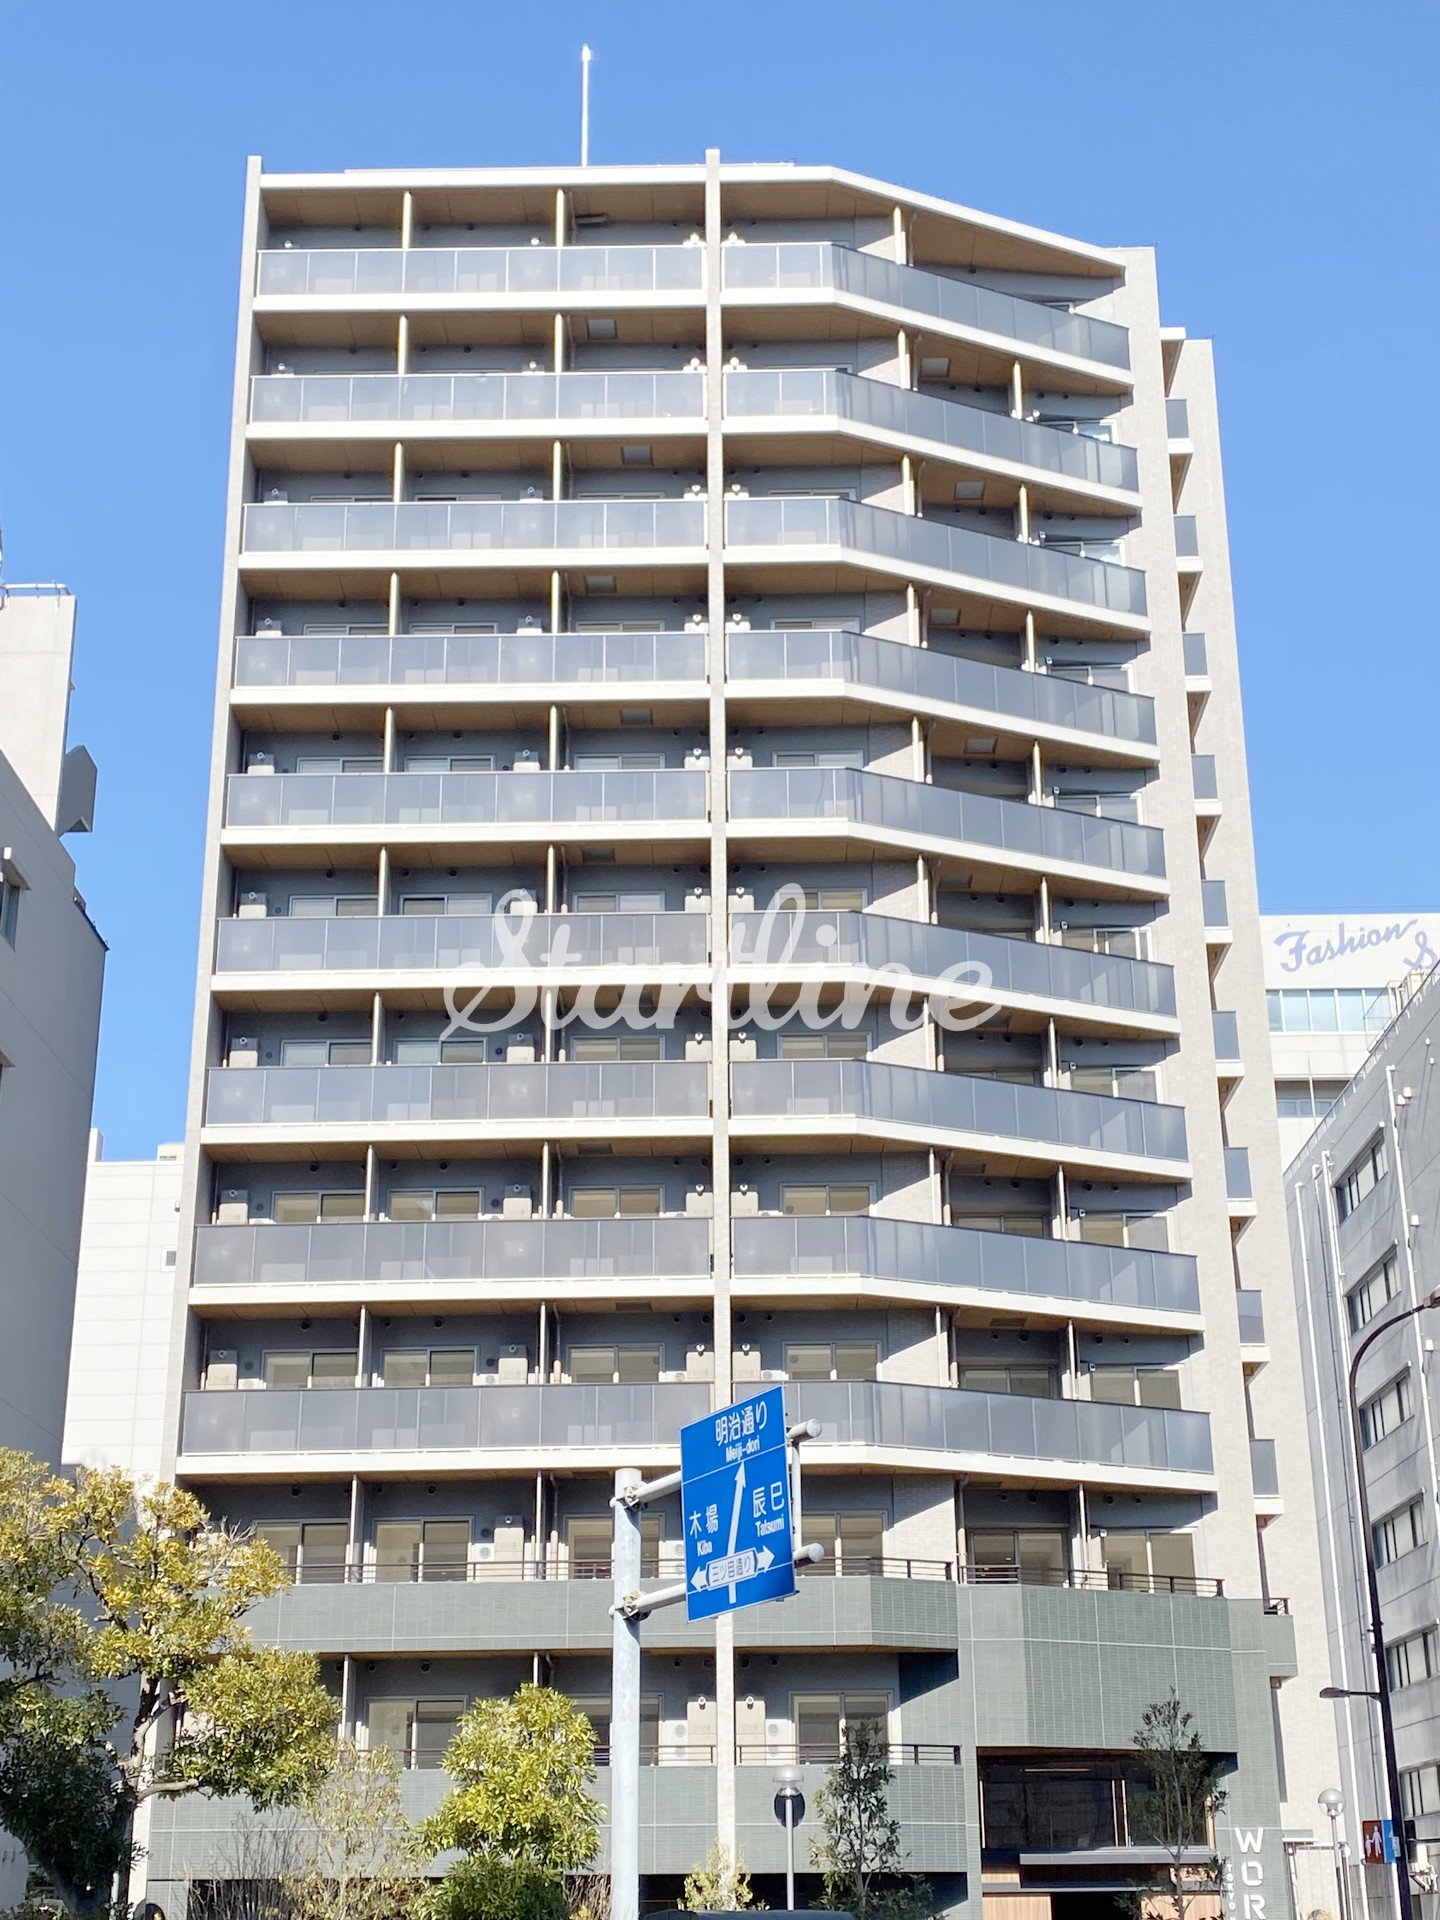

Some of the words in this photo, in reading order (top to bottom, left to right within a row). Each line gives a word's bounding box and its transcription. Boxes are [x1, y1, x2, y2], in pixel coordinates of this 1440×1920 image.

[1273, 918, 1418, 972] Fashion
[715, 1400, 768, 1446] 明治通り
[725, 1434, 761, 1463] Meiji-dori
[752, 1481, 785, 1519] 辰巳
[689, 1503, 719, 1540] 木場
[755, 1513, 785, 1538] Tatsumi
[696, 1539, 713, 1557] Kiba
[711, 1555, 751, 1583] 三ツ目通り
[1225, 1863, 1236, 1910] TOKYO
